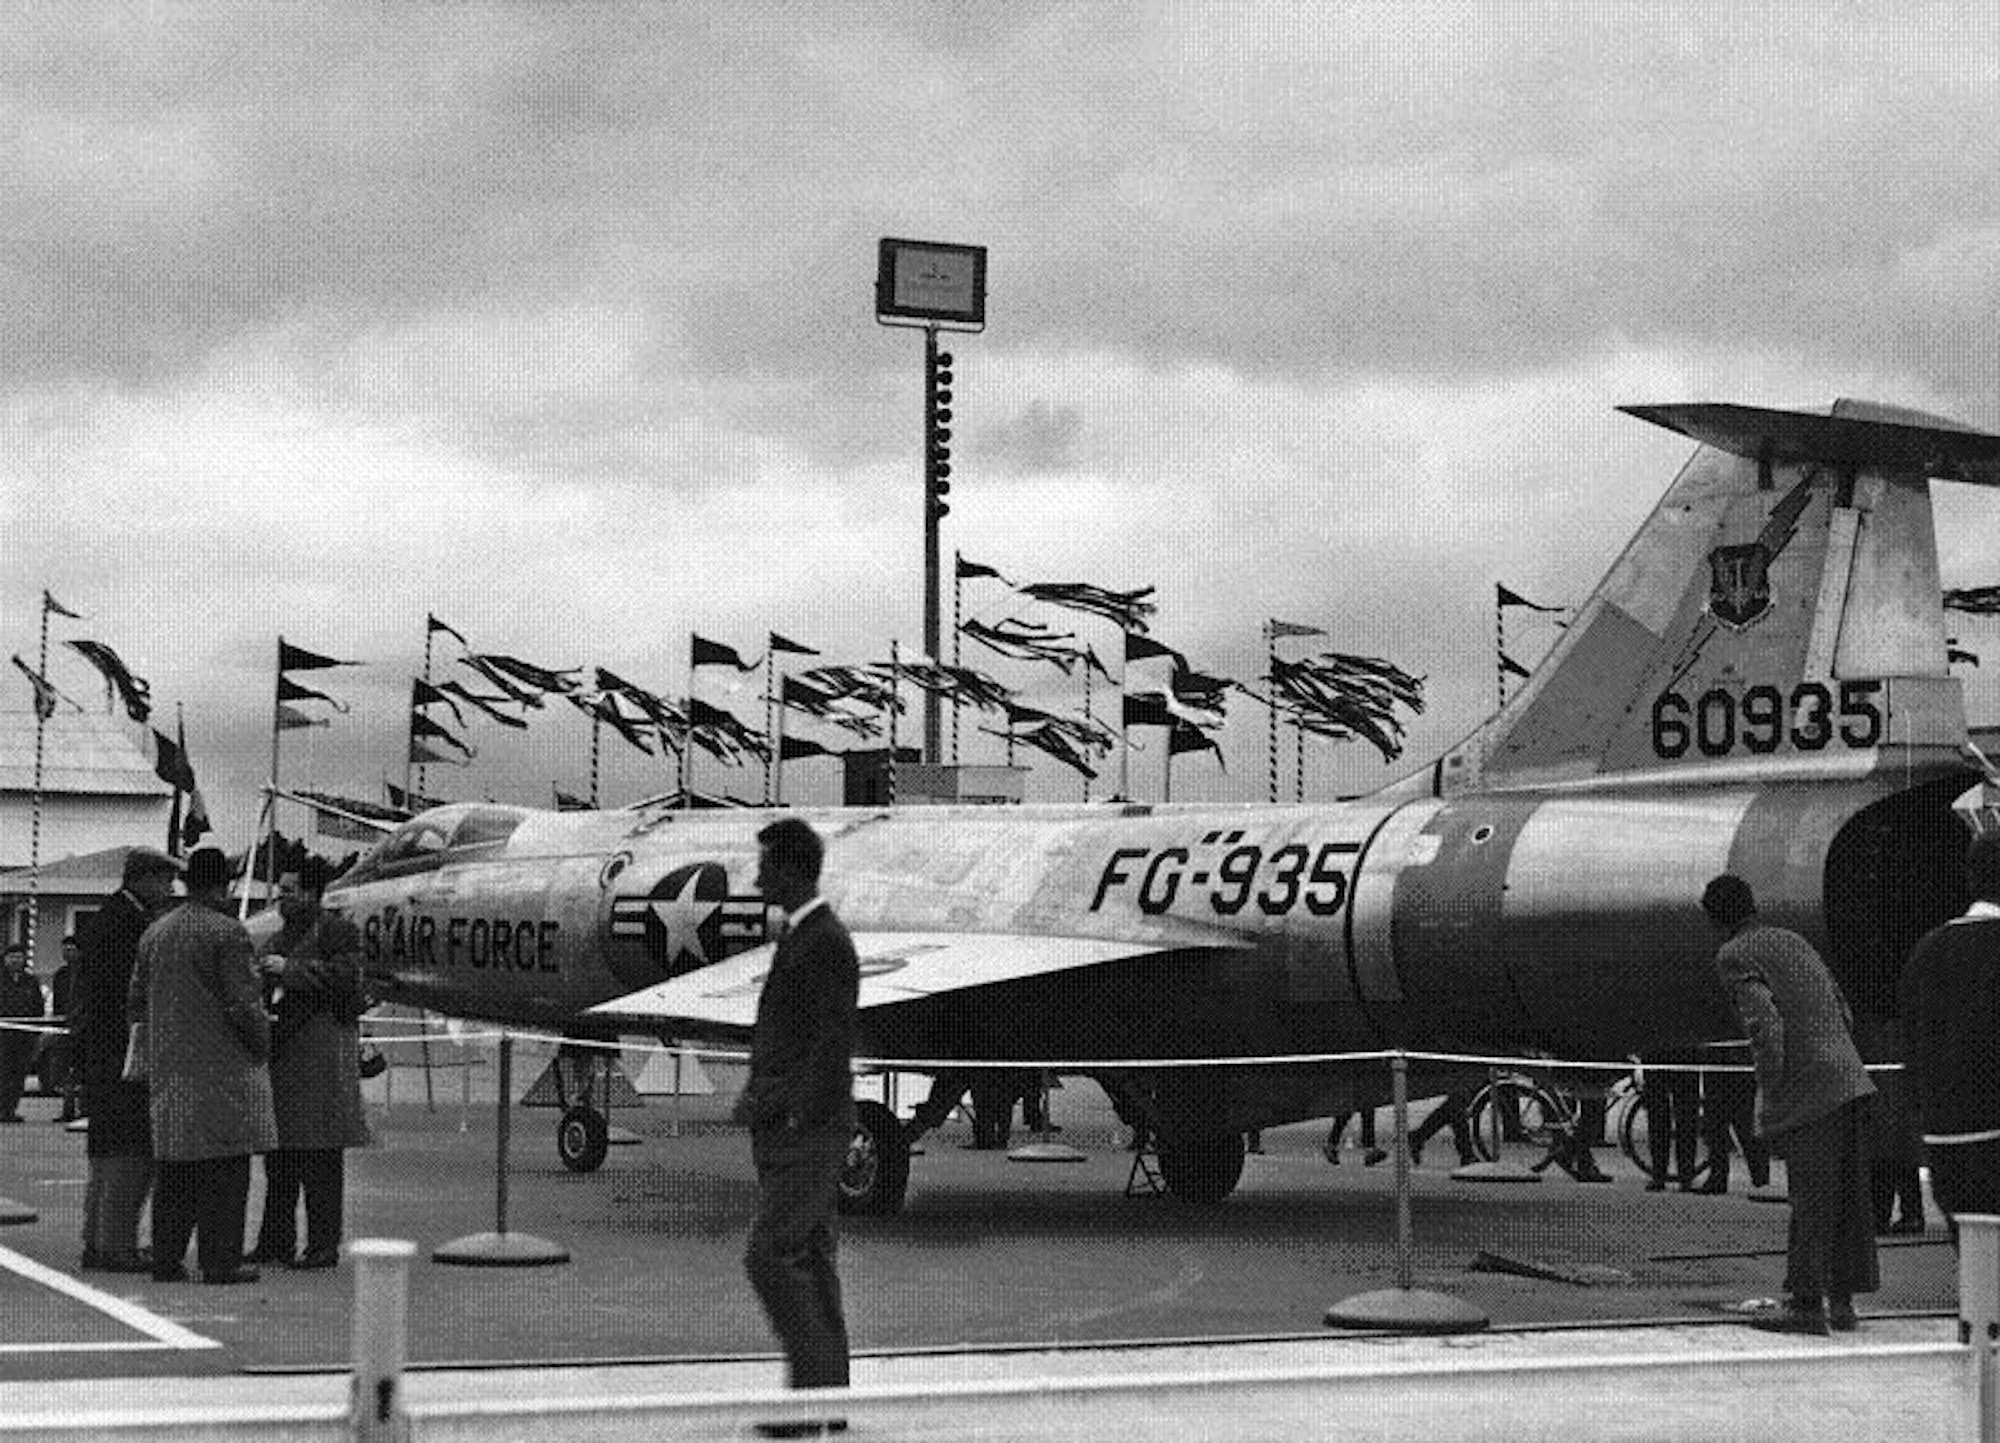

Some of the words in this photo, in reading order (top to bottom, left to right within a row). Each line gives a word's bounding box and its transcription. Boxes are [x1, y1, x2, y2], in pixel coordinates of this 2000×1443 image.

[1652, 681, 1882, 758] 60935
[1090, 843, 1361, 916] FG-935
[388, 916, 437, 966] AIR
[449, 918, 560, 973] FORCE
